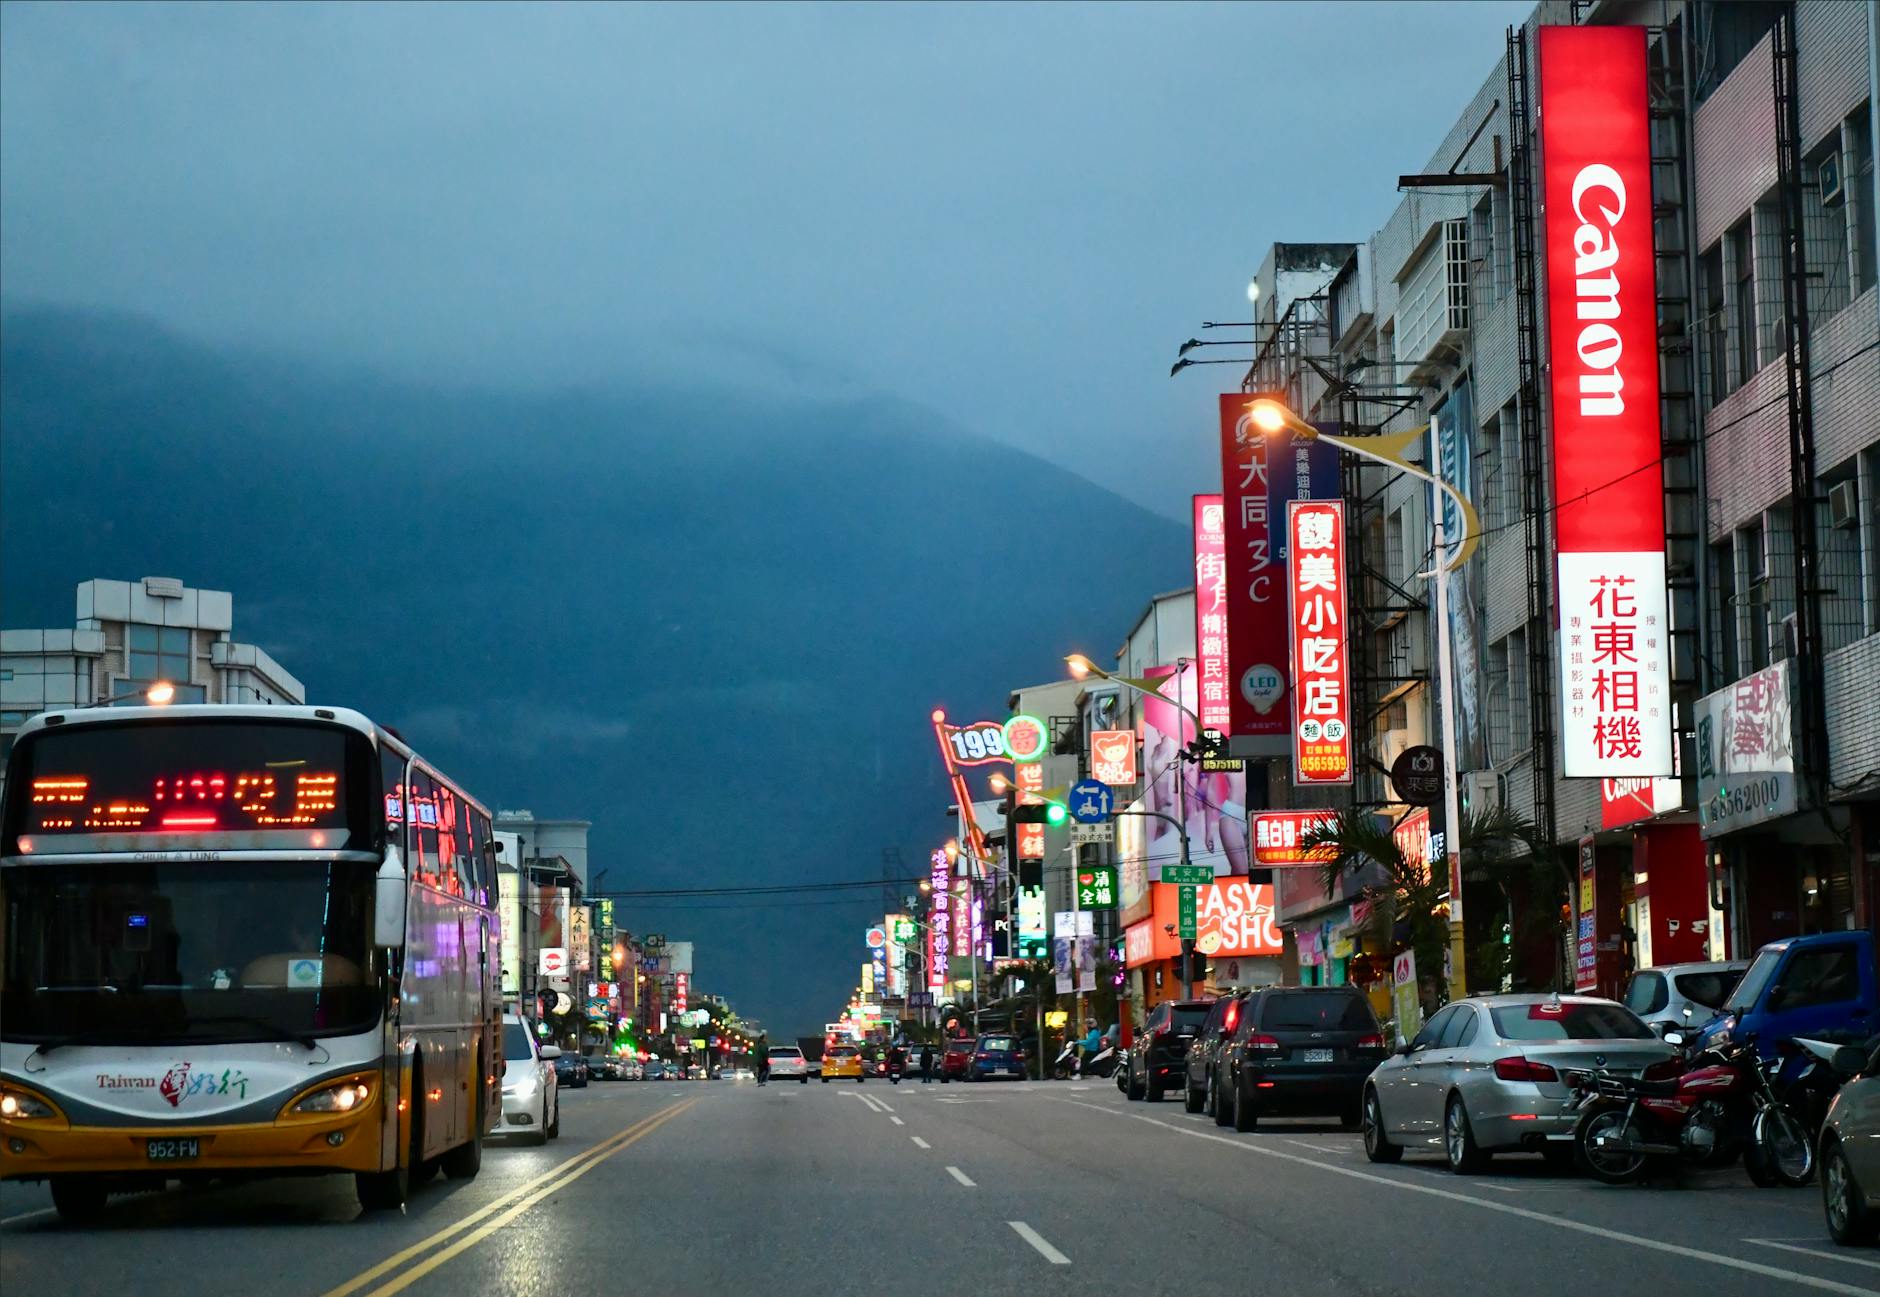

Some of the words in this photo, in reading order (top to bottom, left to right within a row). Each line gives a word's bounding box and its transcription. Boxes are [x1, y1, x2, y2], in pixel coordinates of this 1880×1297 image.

[1572, 164, 1627, 416] Canon
[1202, 613, 1223, 701] 精緻民宿
[1589, 575, 1642, 759] 花東相機
[1249, 676, 1277, 688] LED
[951, 727, 1005, 759] 199
[1095, 762, 1126, 774] EASY
[1301, 756, 1347, 771] 8565939
[1720, 775, 1780, 820] 8562000
[1196, 882, 1263, 918] EASY
[1222, 911, 1284, 949] SHO
[97, 1074, 156, 1088] Taiwan
[147, 1139, 199, 1158] 952-FW
